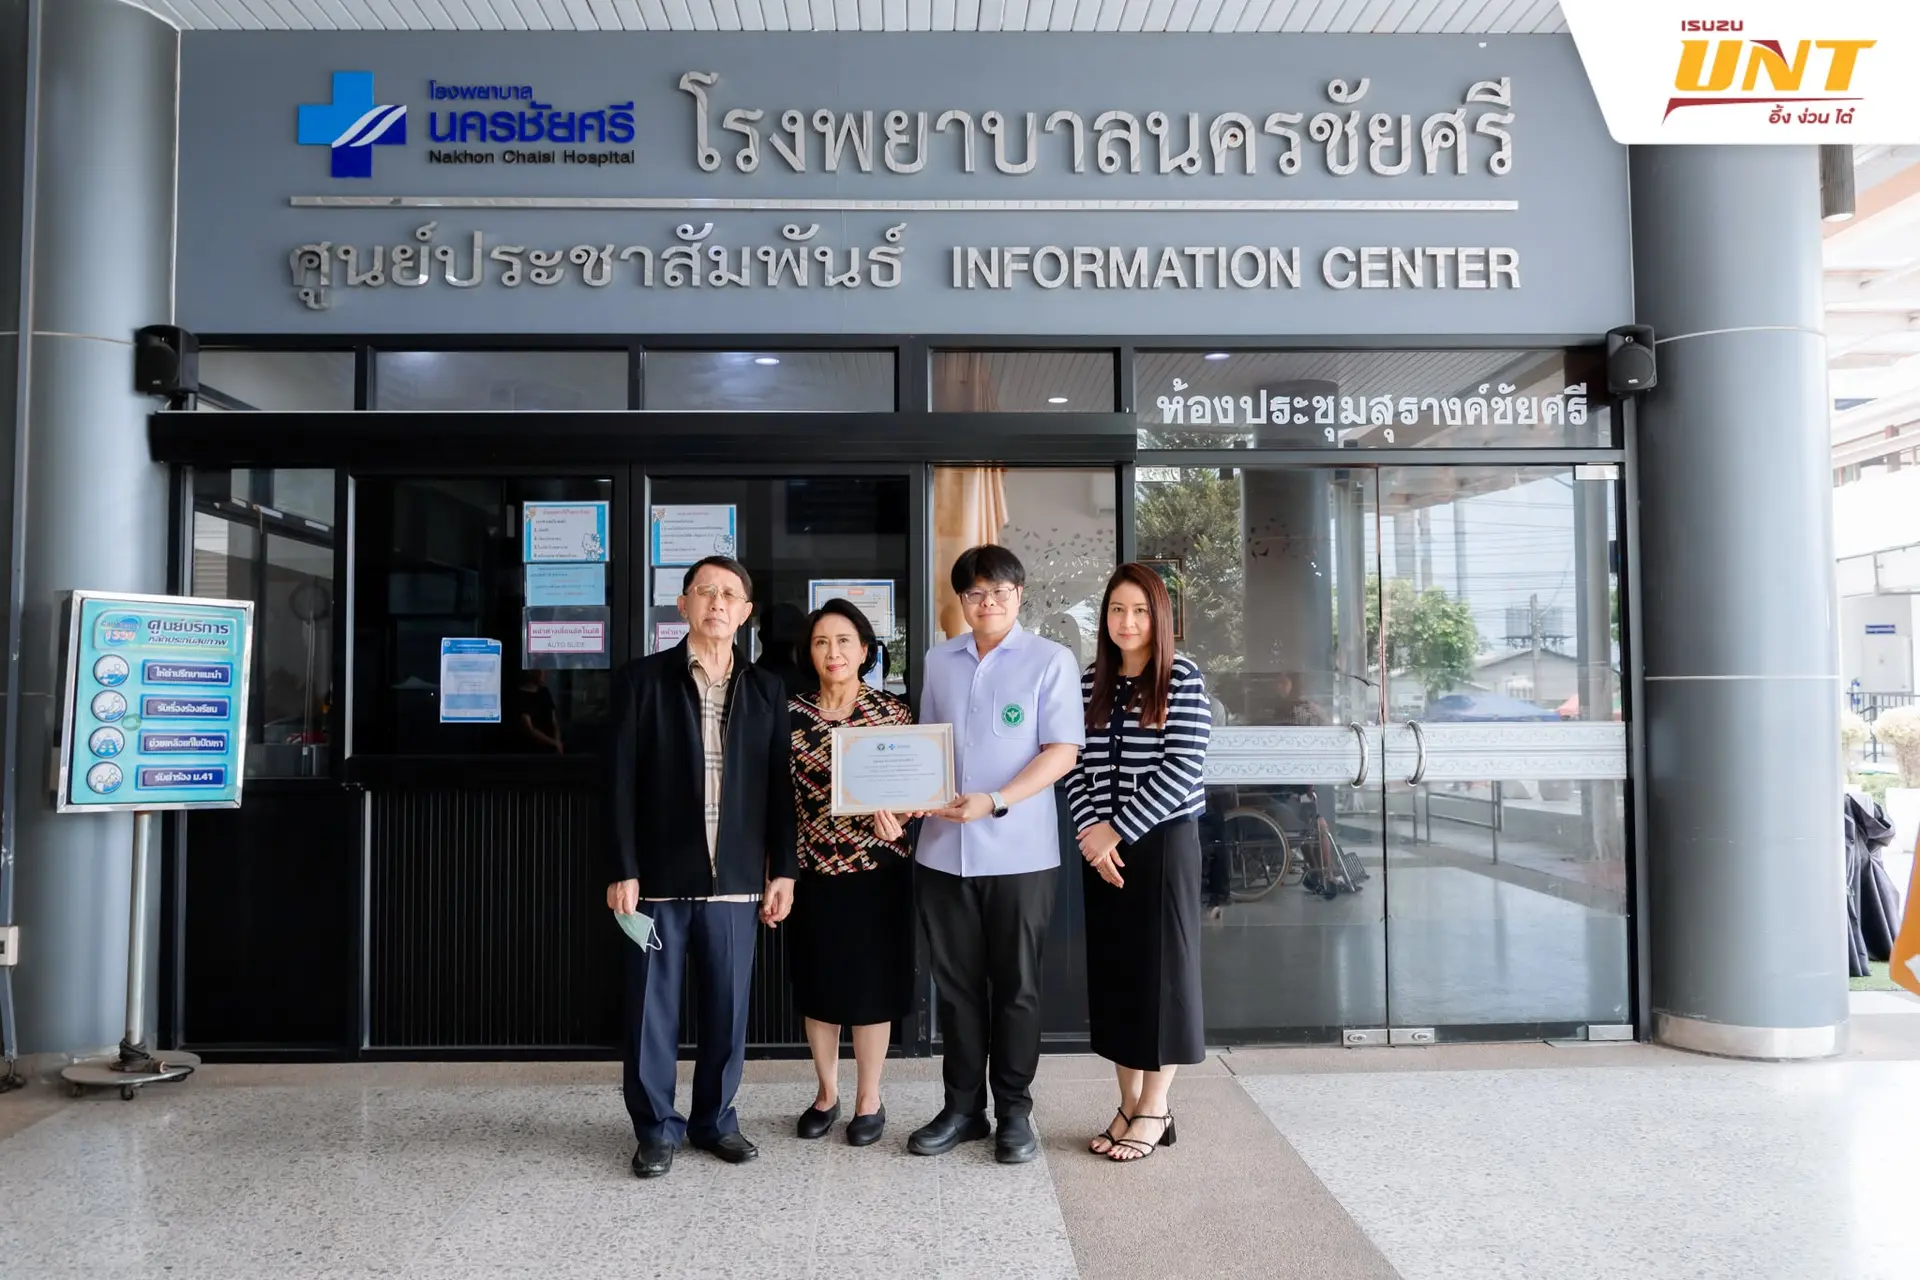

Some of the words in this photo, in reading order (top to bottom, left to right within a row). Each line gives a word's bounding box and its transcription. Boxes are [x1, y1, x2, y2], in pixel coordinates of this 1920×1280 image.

[429, 80, 533, 100] โรงพยาบาล
[429, 101, 635, 143] นครชัยศรี
[679, 71, 1515, 176] โรงพยาบาลนครชัยศรี
[429, 150, 494, 164] Nakhon
[502, 150, 555, 164] Chaisi
[564, 150, 635, 167] Hospital
[289, 221, 906, 310] ศูนย์ประชาสัมพันธ์
[952, 245, 1302, 290] INFORMATION
[1322, 245, 1521, 290] CENTER
[1156, 377, 1588, 443] ห้องประชุมสุรางค์ชัยศรี
[147, 617, 229, 635] ศูนย์บริการ
